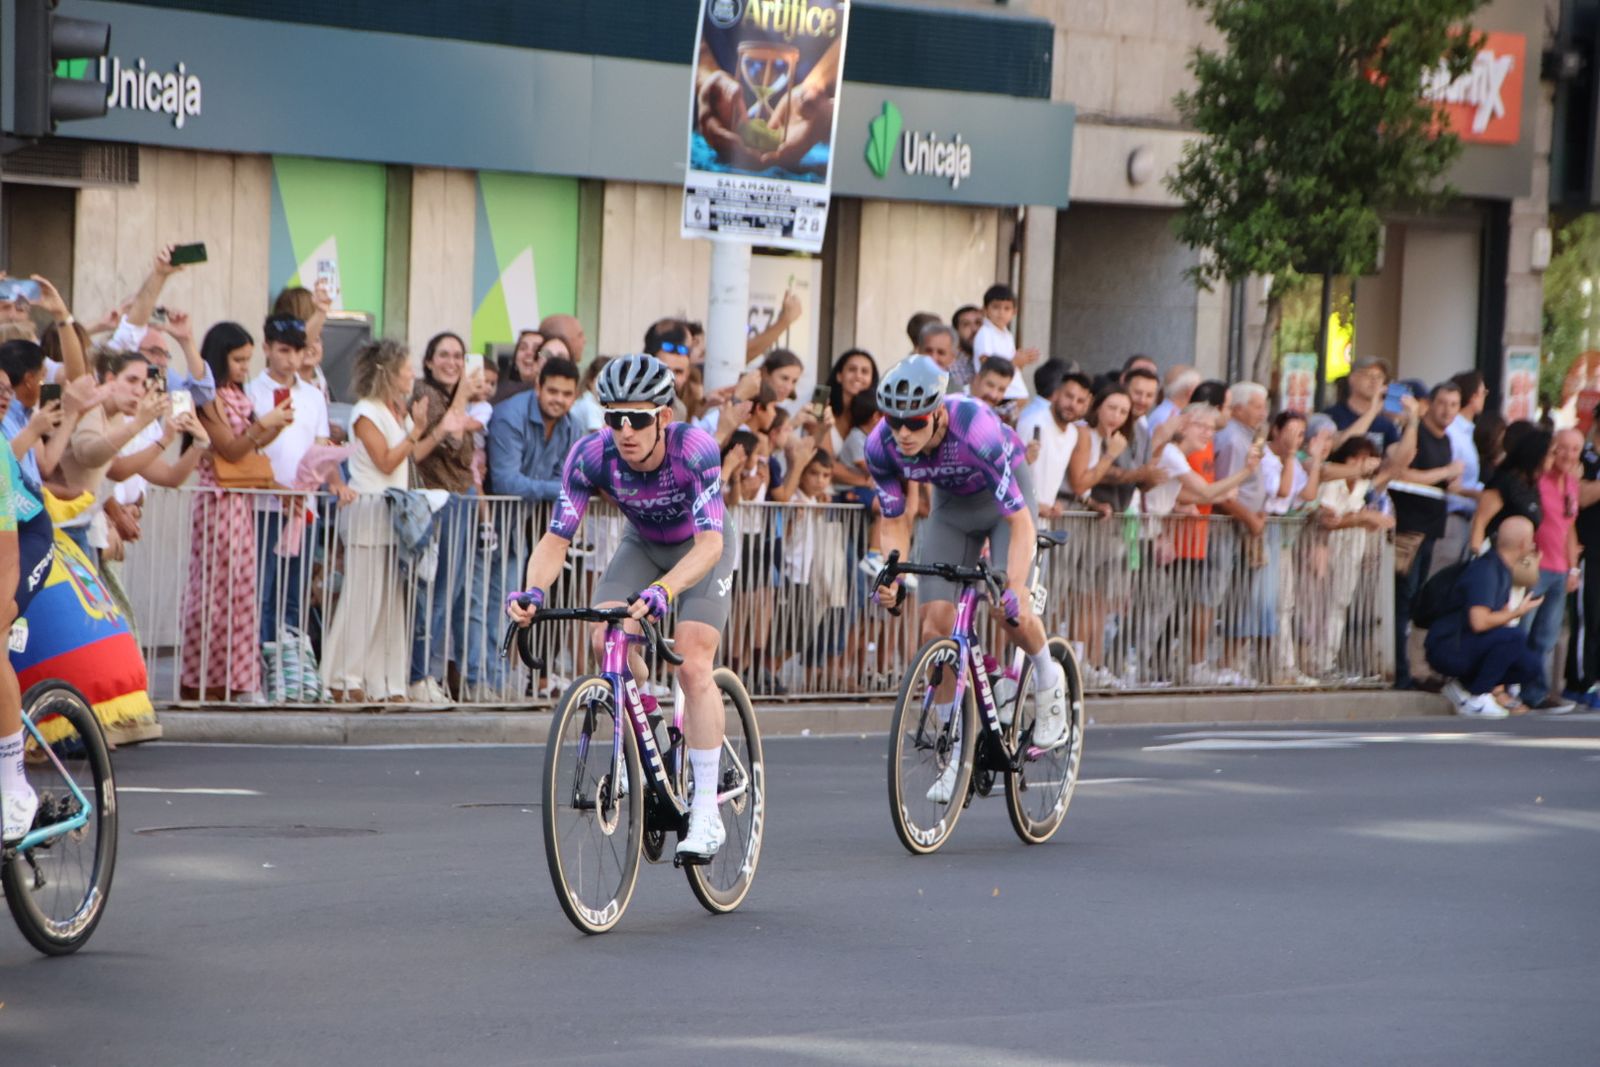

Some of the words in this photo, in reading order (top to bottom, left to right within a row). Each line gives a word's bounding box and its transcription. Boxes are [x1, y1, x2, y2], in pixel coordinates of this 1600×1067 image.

[716, 178, 793, 194] SALAMANCA
[903, 129, 972, 191] Unicaja
[694, 206, 703, 221] 6
[618, 493, 687, 509] ayco
[970, 645, 1003, 733] GIANT
[625, 678, 669, 783] GIANT
[742, 761, 764, 884] CADEX
